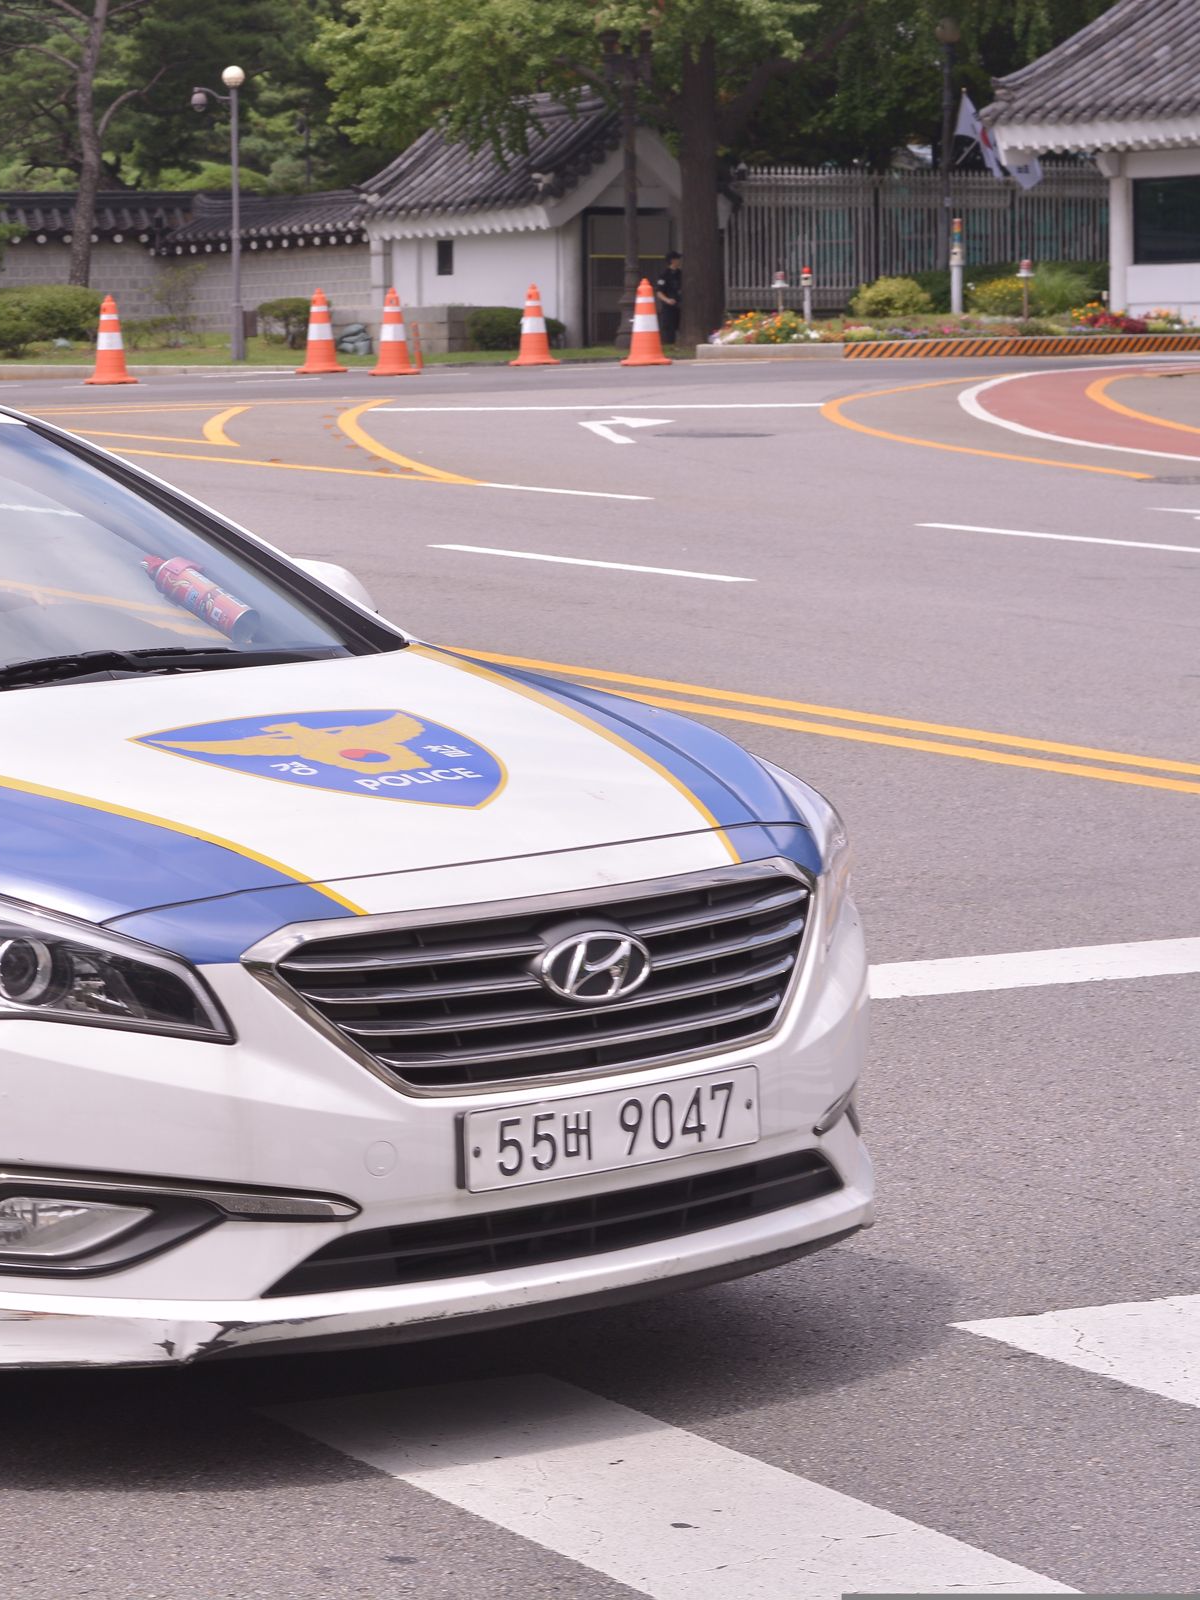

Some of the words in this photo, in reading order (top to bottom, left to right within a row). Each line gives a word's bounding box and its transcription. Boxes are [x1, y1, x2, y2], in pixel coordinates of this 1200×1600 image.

[269, 761, 319, 776] 경
[422, 744, 473, 758] 찰
[353, 767, 483, 792] POLICE
[498, 1110, 593, 1177] 55버
[620, 1081, 735, 1156] 9047
